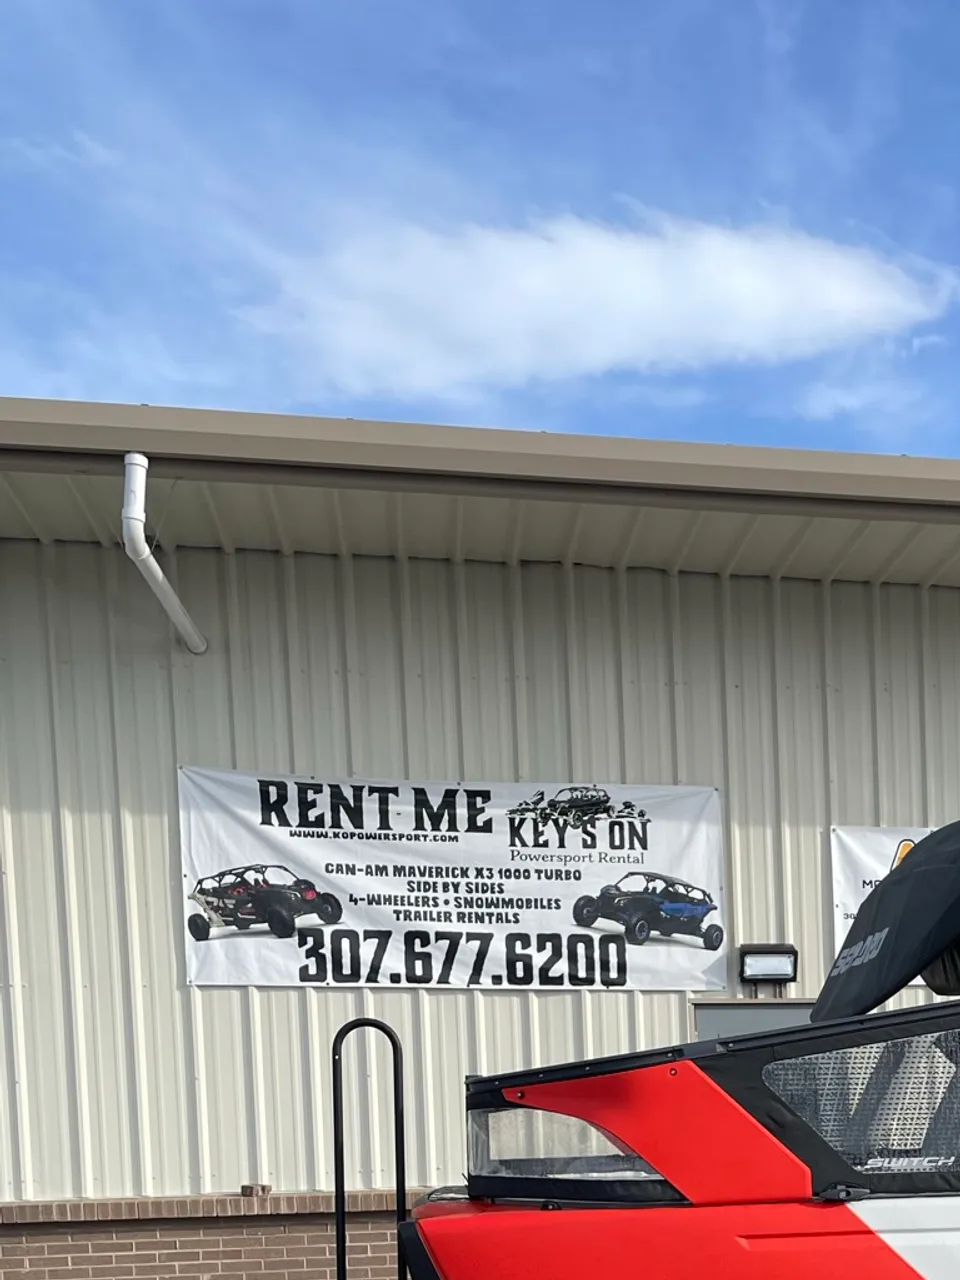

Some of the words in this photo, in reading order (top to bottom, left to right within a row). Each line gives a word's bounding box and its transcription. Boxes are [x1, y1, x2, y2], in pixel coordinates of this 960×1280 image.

[257, 779, 399, 830] RENT
[411, 787, 493, 833] ME
[289, 829, 459, 843] WWW.KOPOWERSPORT.COM
[608, 820, 650, 850] ON
[510, 849, 594, 866] Powersport
[598, 852, 644, 864] Rental
[325, 862, 389, 878] CAN-AM
[392, 865, 470, 879] MAVERICK
[474, 867, 494, 880] X3
[498, 867, 531, 880] 1000
[534, 868, 582, 881] TURBO
[406, 880, 439, 893] SIDE
[442, 881, 460, 894] BY
[465, 881, 505, 894] SIDES
[349, 894, 440, 908] 4-WHEELERS
[453, 896, 562, 910] SNOWMOBILES
[393, 909, 453, 923] TRAILER
[456, 910, 521, 924] RENTALS
[297, 928, 627, 987] 307.677.6200
[864, 1156, 955, 1168] SWITCH
